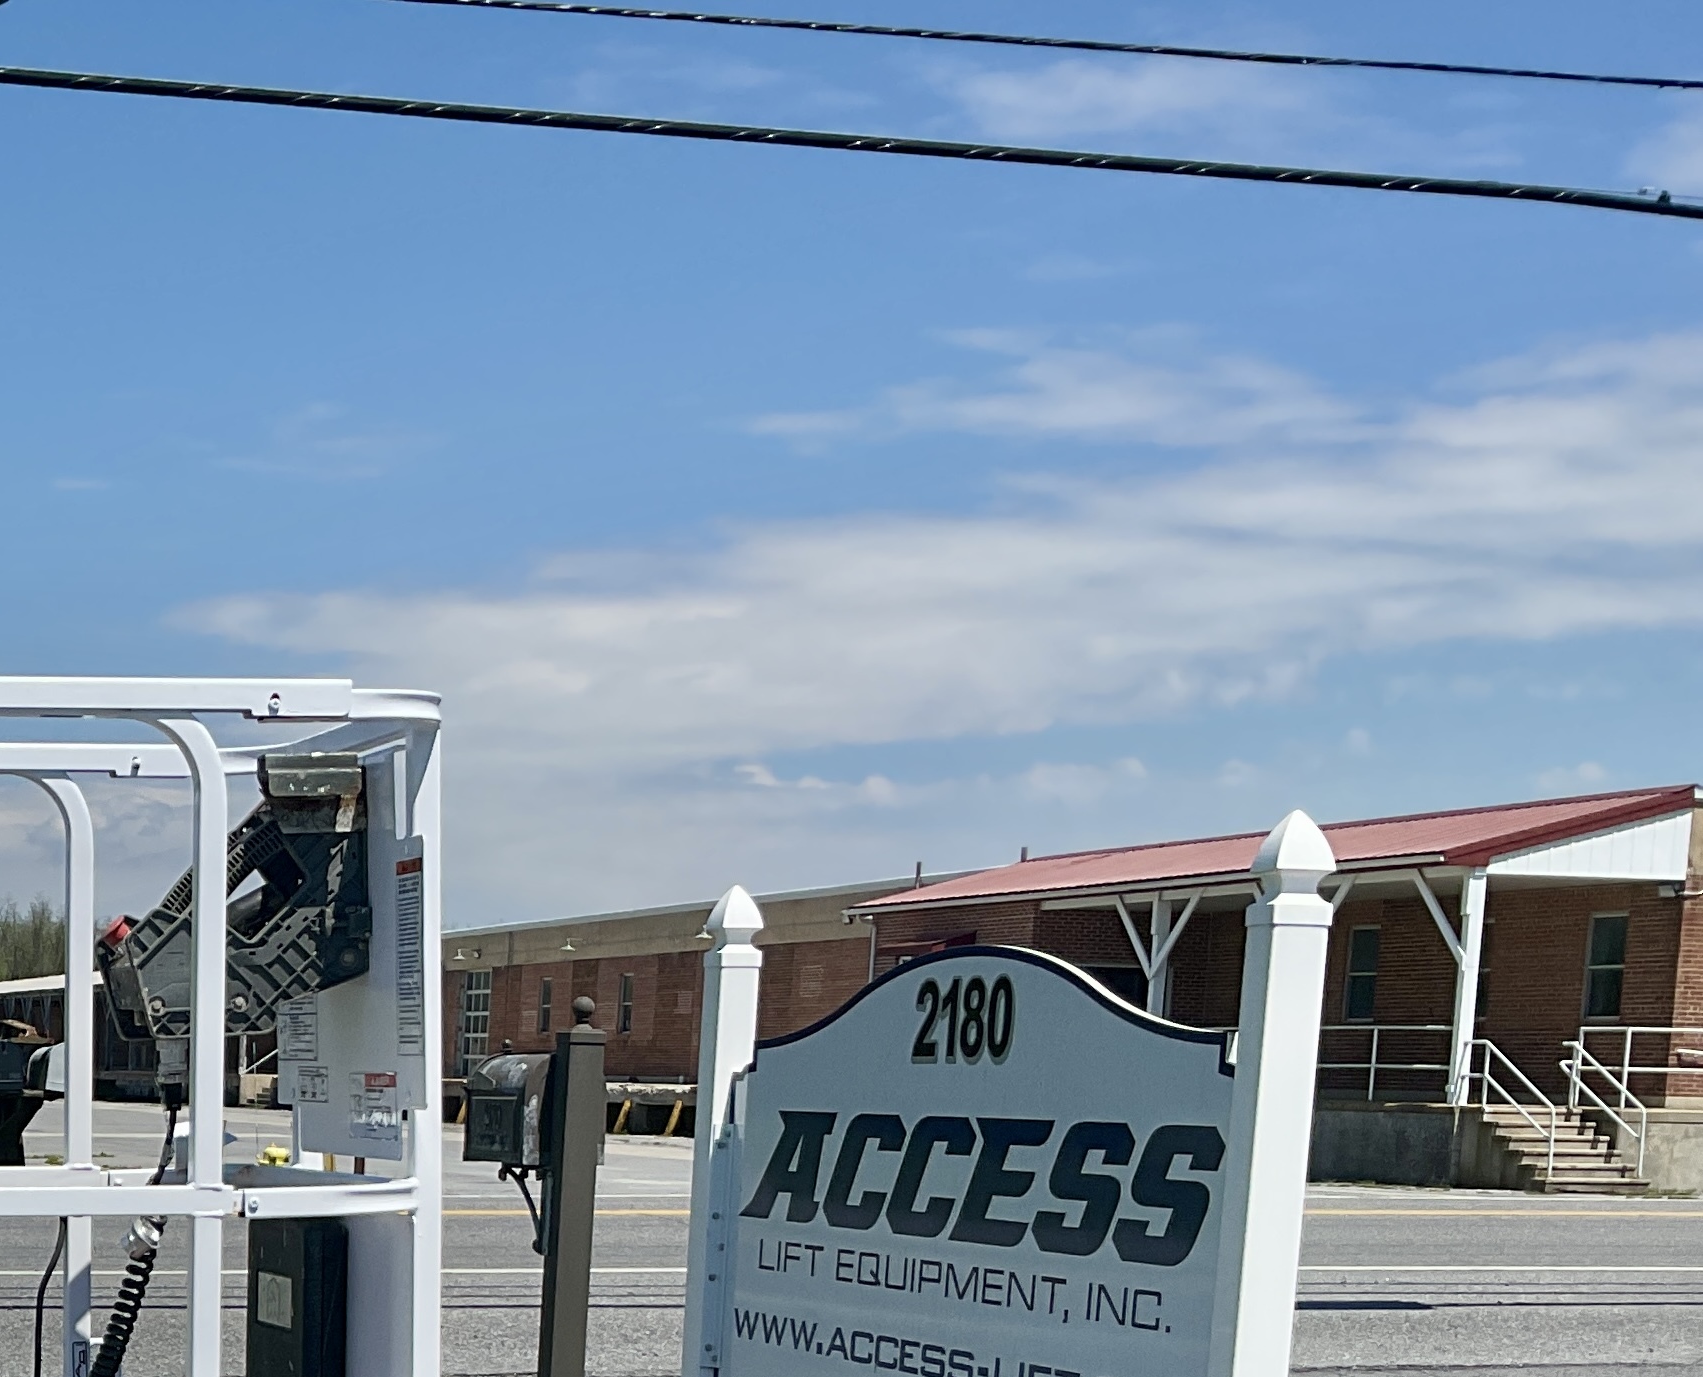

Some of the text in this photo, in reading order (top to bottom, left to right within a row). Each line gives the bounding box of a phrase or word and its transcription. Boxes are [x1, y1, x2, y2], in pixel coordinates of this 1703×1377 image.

[910, 972, 1016, 1065] 2180
[738, 1109, 1227, 1267] ACCESS
[757, 1238, 1172, 1334] LIFT EQUIPMENT, INC.
